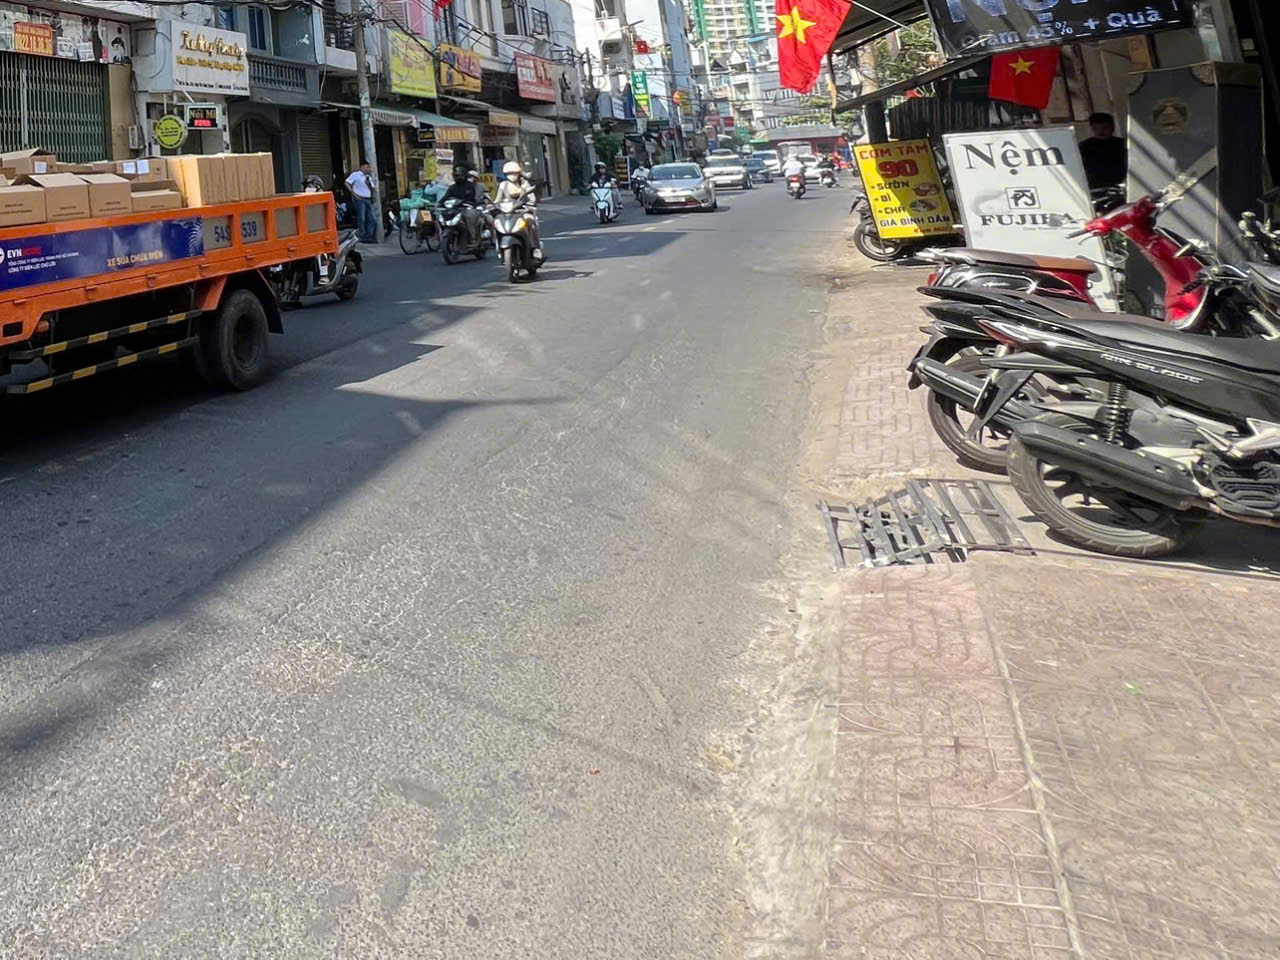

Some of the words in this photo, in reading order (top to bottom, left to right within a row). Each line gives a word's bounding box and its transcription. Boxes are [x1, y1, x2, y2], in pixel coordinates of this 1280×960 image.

[1106, 6, 1164, 29] Quà
[878, 158, 919, 179] 90
[961, 140, 1066, 176] Nệm
